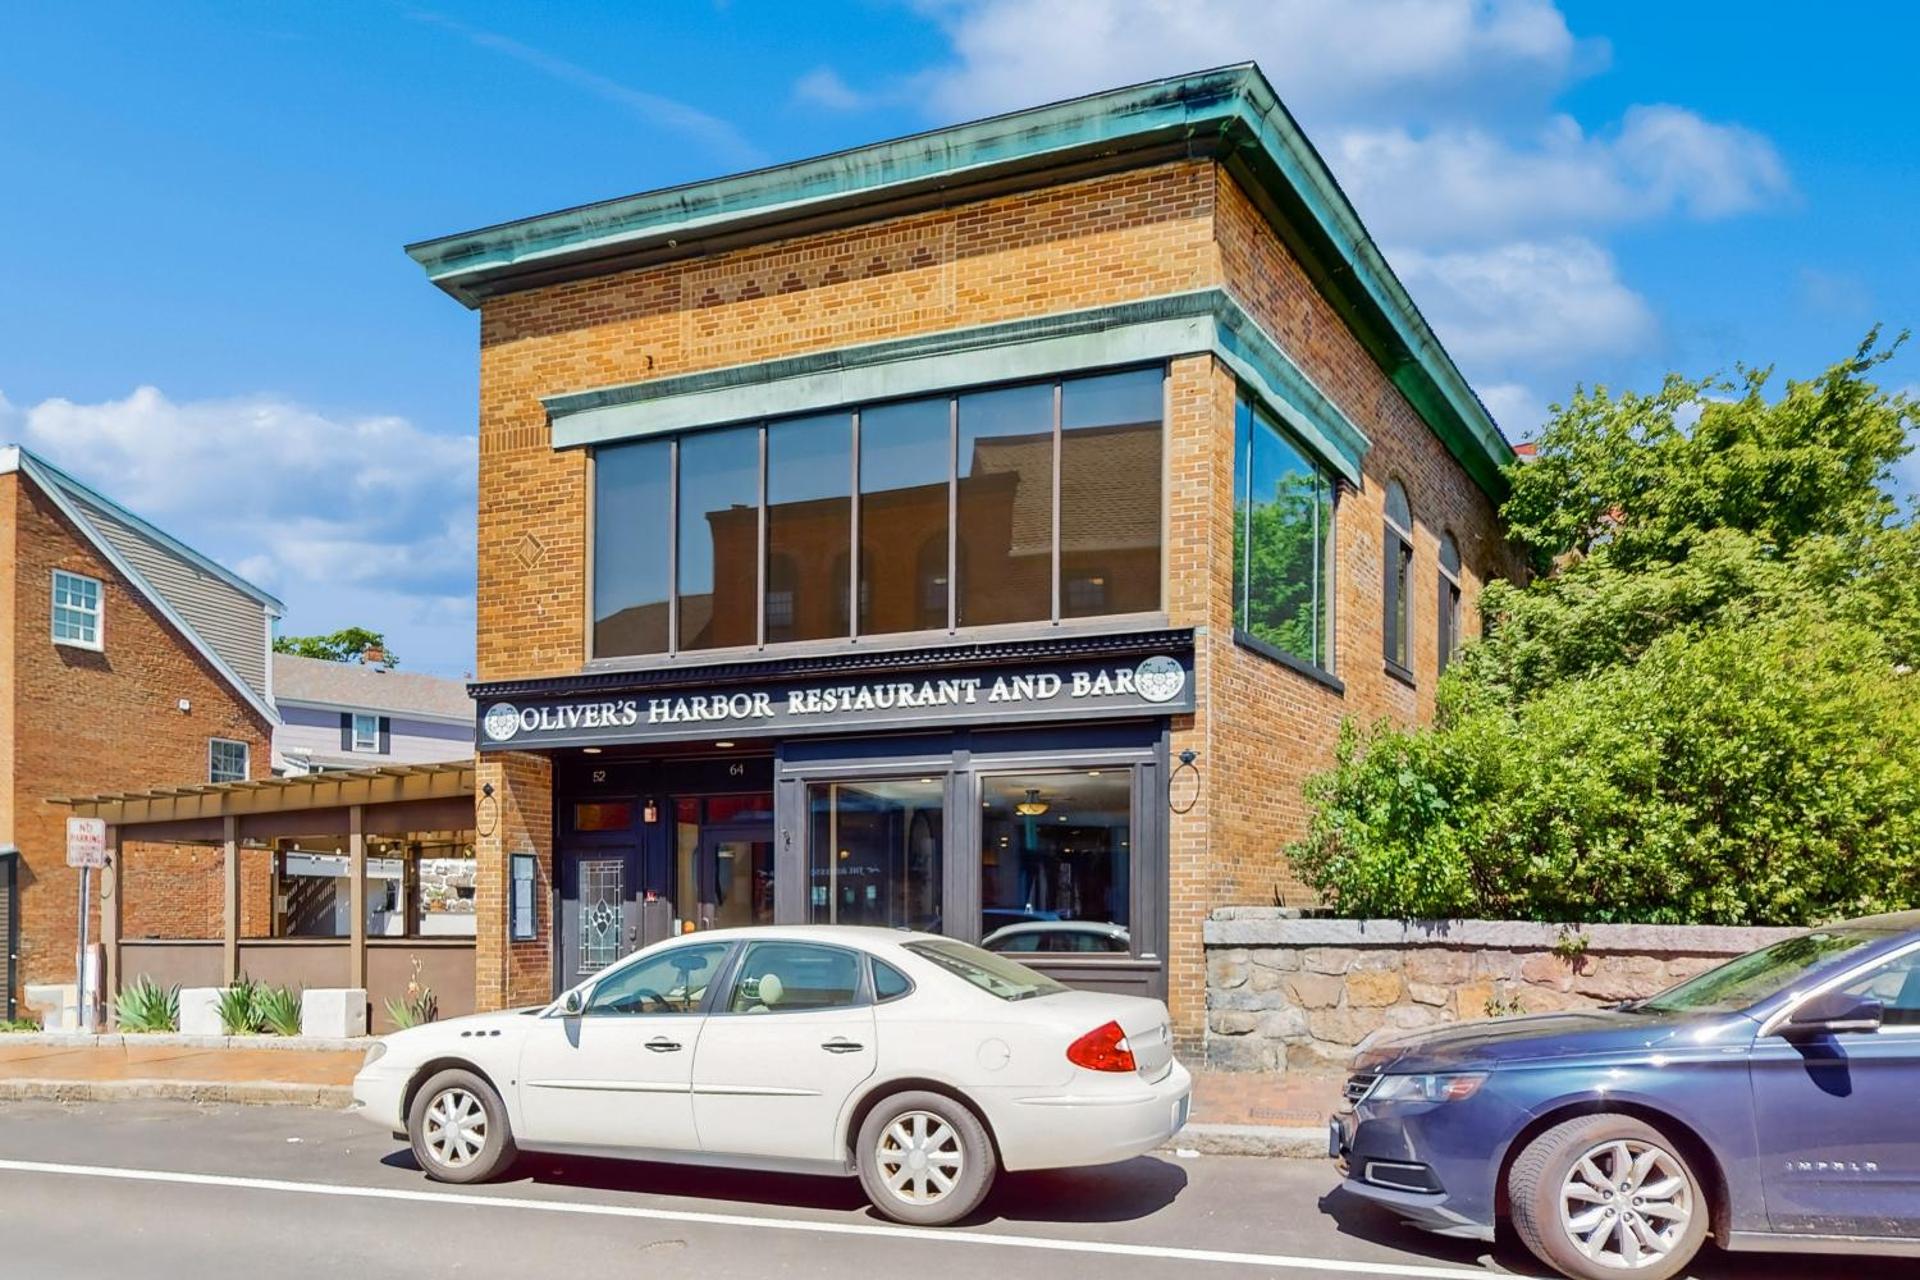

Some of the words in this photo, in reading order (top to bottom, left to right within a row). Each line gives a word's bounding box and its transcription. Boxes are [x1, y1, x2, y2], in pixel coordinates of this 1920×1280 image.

[520, 700, 637, 732] OLIVER'S
[648, 692, 774, 724] HARBOR
[788, 677, 981, 715] RESTAURANT
[989, 672, 1062, 702] AND
[1071, 667, 1138, 697] BAR
[593, 770, 607, 783] 52
[729, 763, 744, 777] 64
